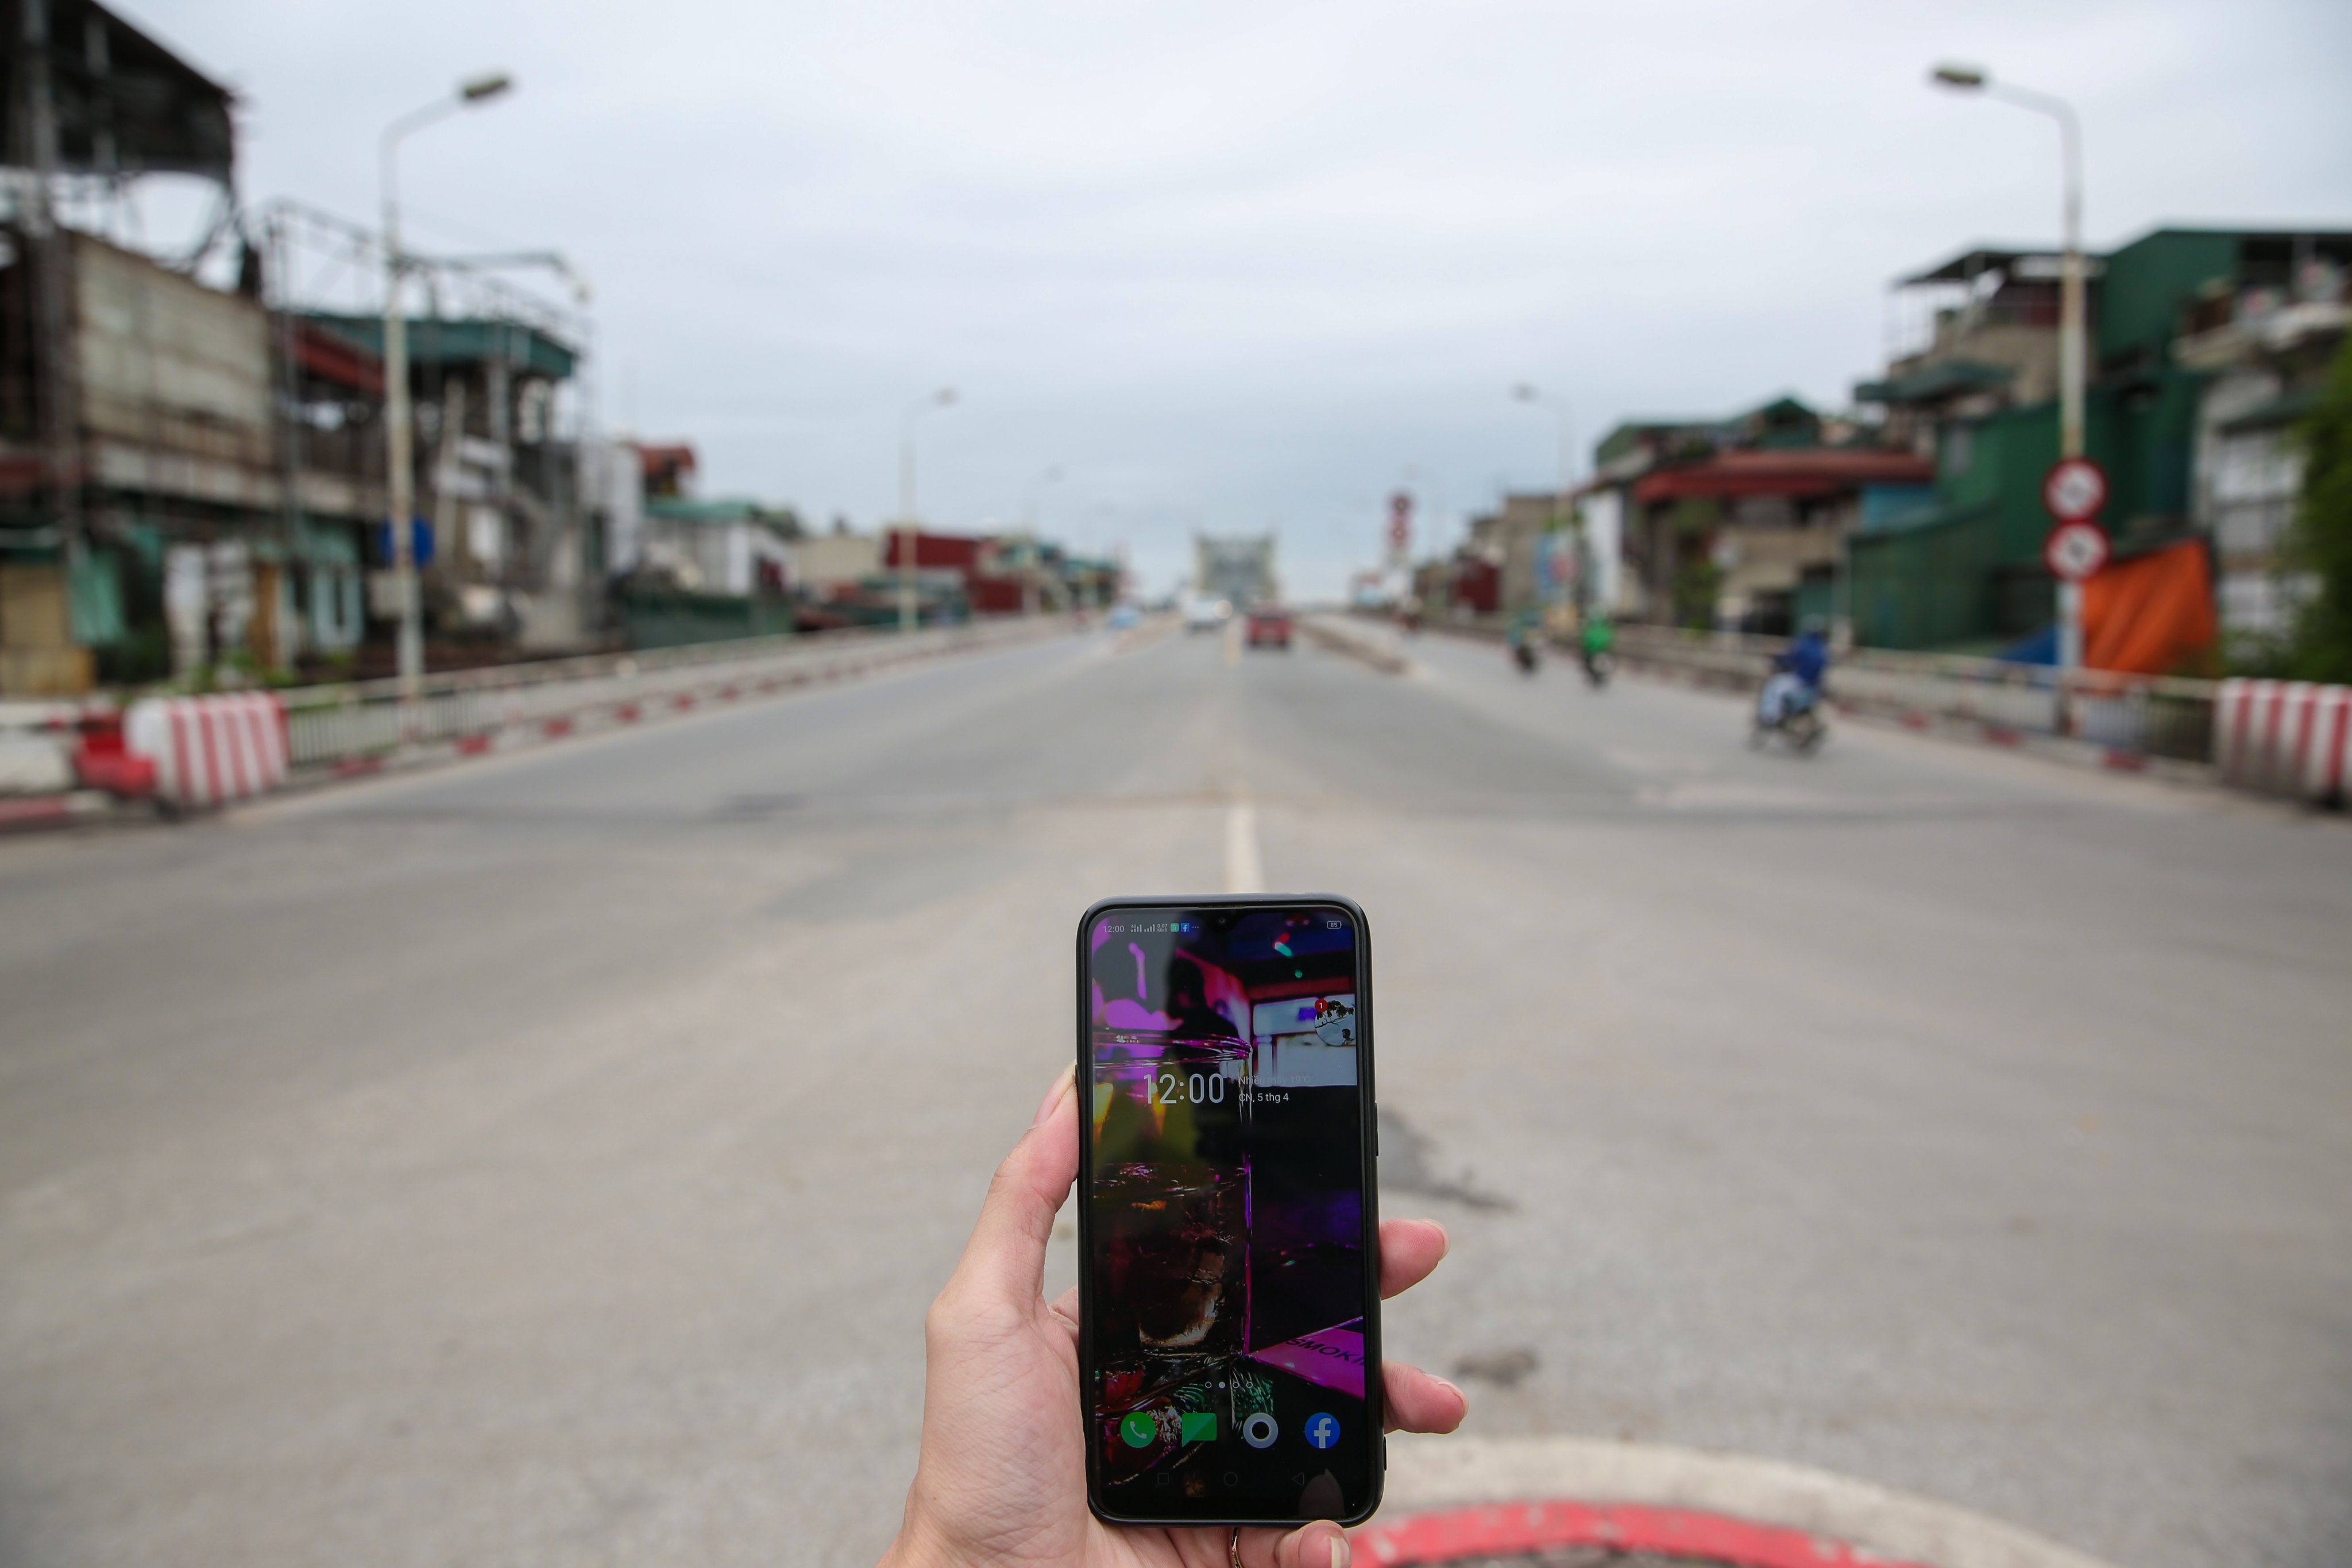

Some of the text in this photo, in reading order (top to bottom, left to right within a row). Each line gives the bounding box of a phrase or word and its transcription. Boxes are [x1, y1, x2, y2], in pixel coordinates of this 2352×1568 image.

[1144, 1073, 1224, 1104] 12:00
[1239, 1092, 1289, 1103] CN, 5 thg 4
